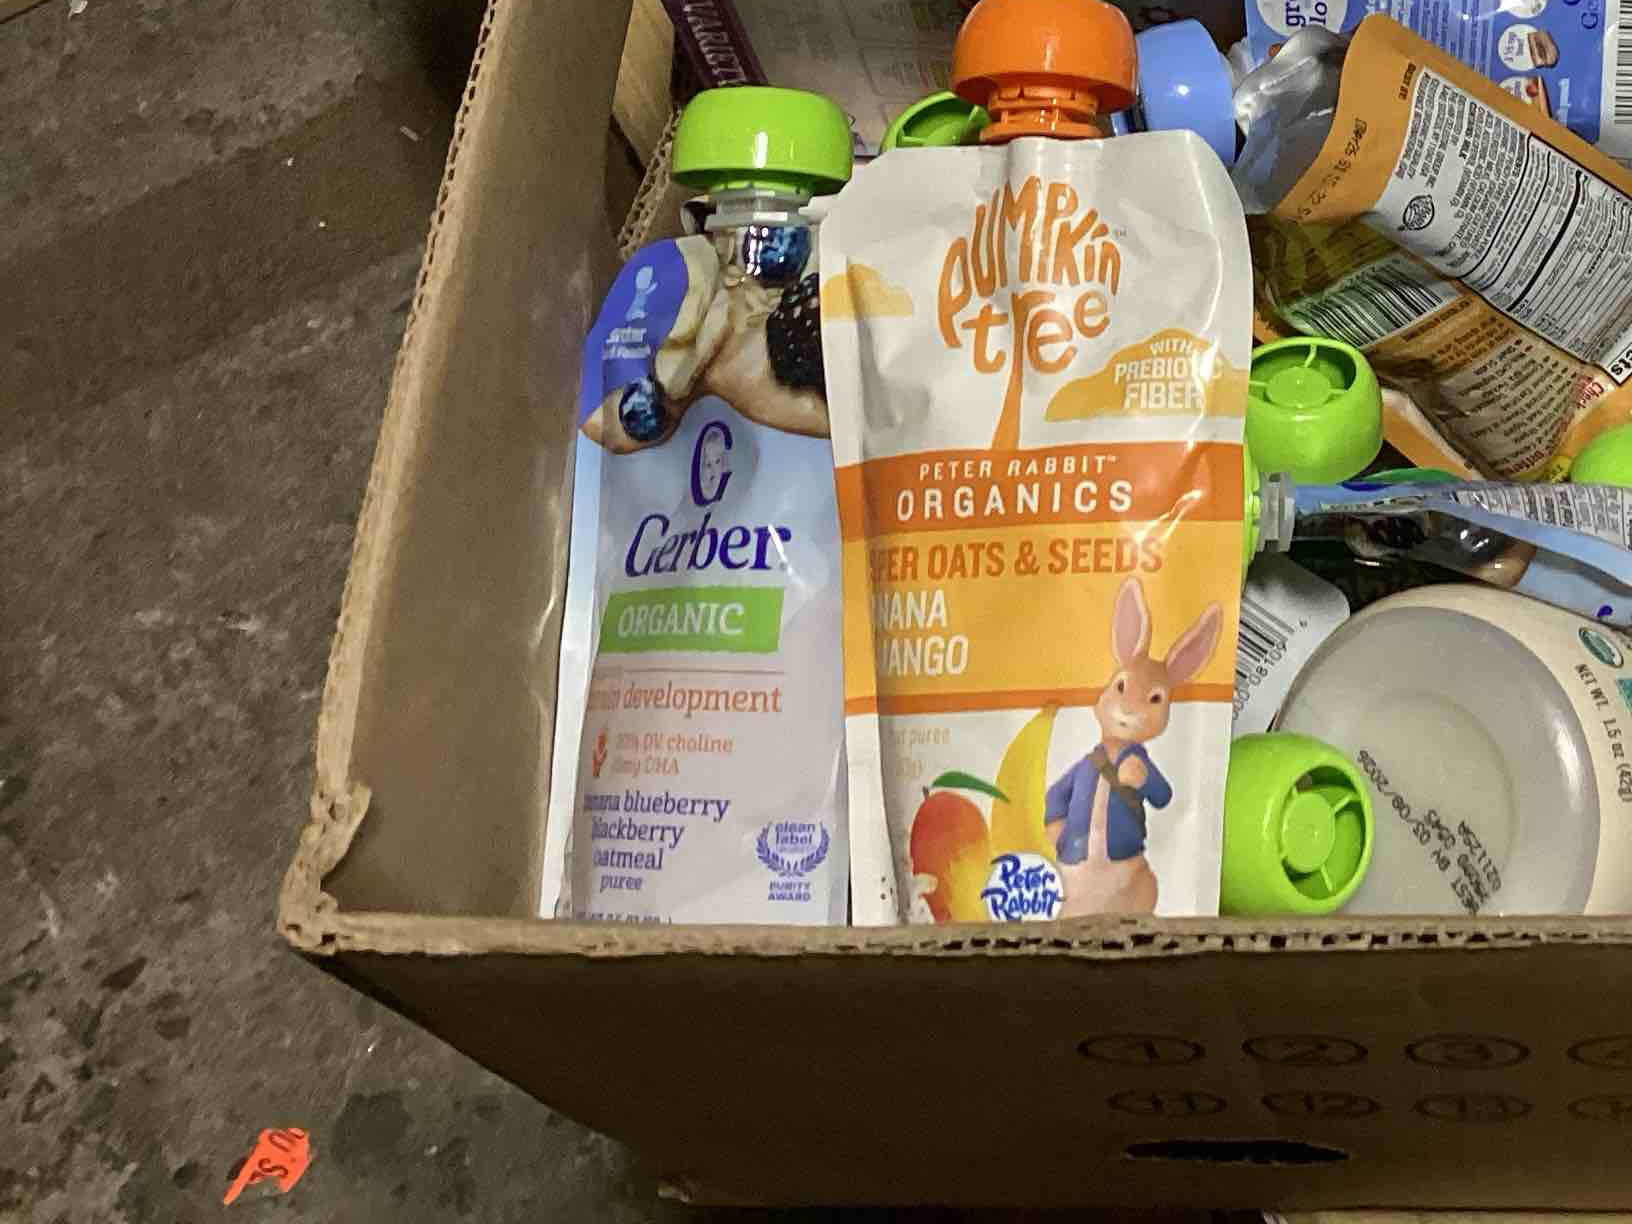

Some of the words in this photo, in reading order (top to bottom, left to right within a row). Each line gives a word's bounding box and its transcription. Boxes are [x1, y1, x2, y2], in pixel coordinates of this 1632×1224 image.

[961, 288, 1111, 376] tree
[1149, 338, 1193, 356] WITH
[1124, 381, 1205, 409] FIBER
[919, 459, 992, 481] PETER
[896, 479, 1134, 522] ORGANICS
[624, 512, 792, 578] Gerber
[927, 539, 1005, 579] OATS
[1014, 539, 1041, 577] &
[1047, 537, 1163, 575] SEEDS
[618, 602, 745, 638] ORGANIC
[623, 680, 783, 719] development
[1574, 663, 1595, 687] NET
[1588, 688, 1609, 712] WT.
[1602, 717, 1625, 739] 1.5
[666, 734, 734, 754] choline
[644, 757, 680, 776] DHA
[623, 789, 731, 822] blueberry
[774, 822, 816, 833] clean
[775, 832, 813, 845] label
[592, 847, 664, 871] oatmeal
[991, 853, 1056, 891] Peter
[599, 873, 643, 893] puree
[767, 891, 811, 902] AWARD
[769, 880, 812, 892] PURITY
[980, 888, 1064, 920] Rabbit
